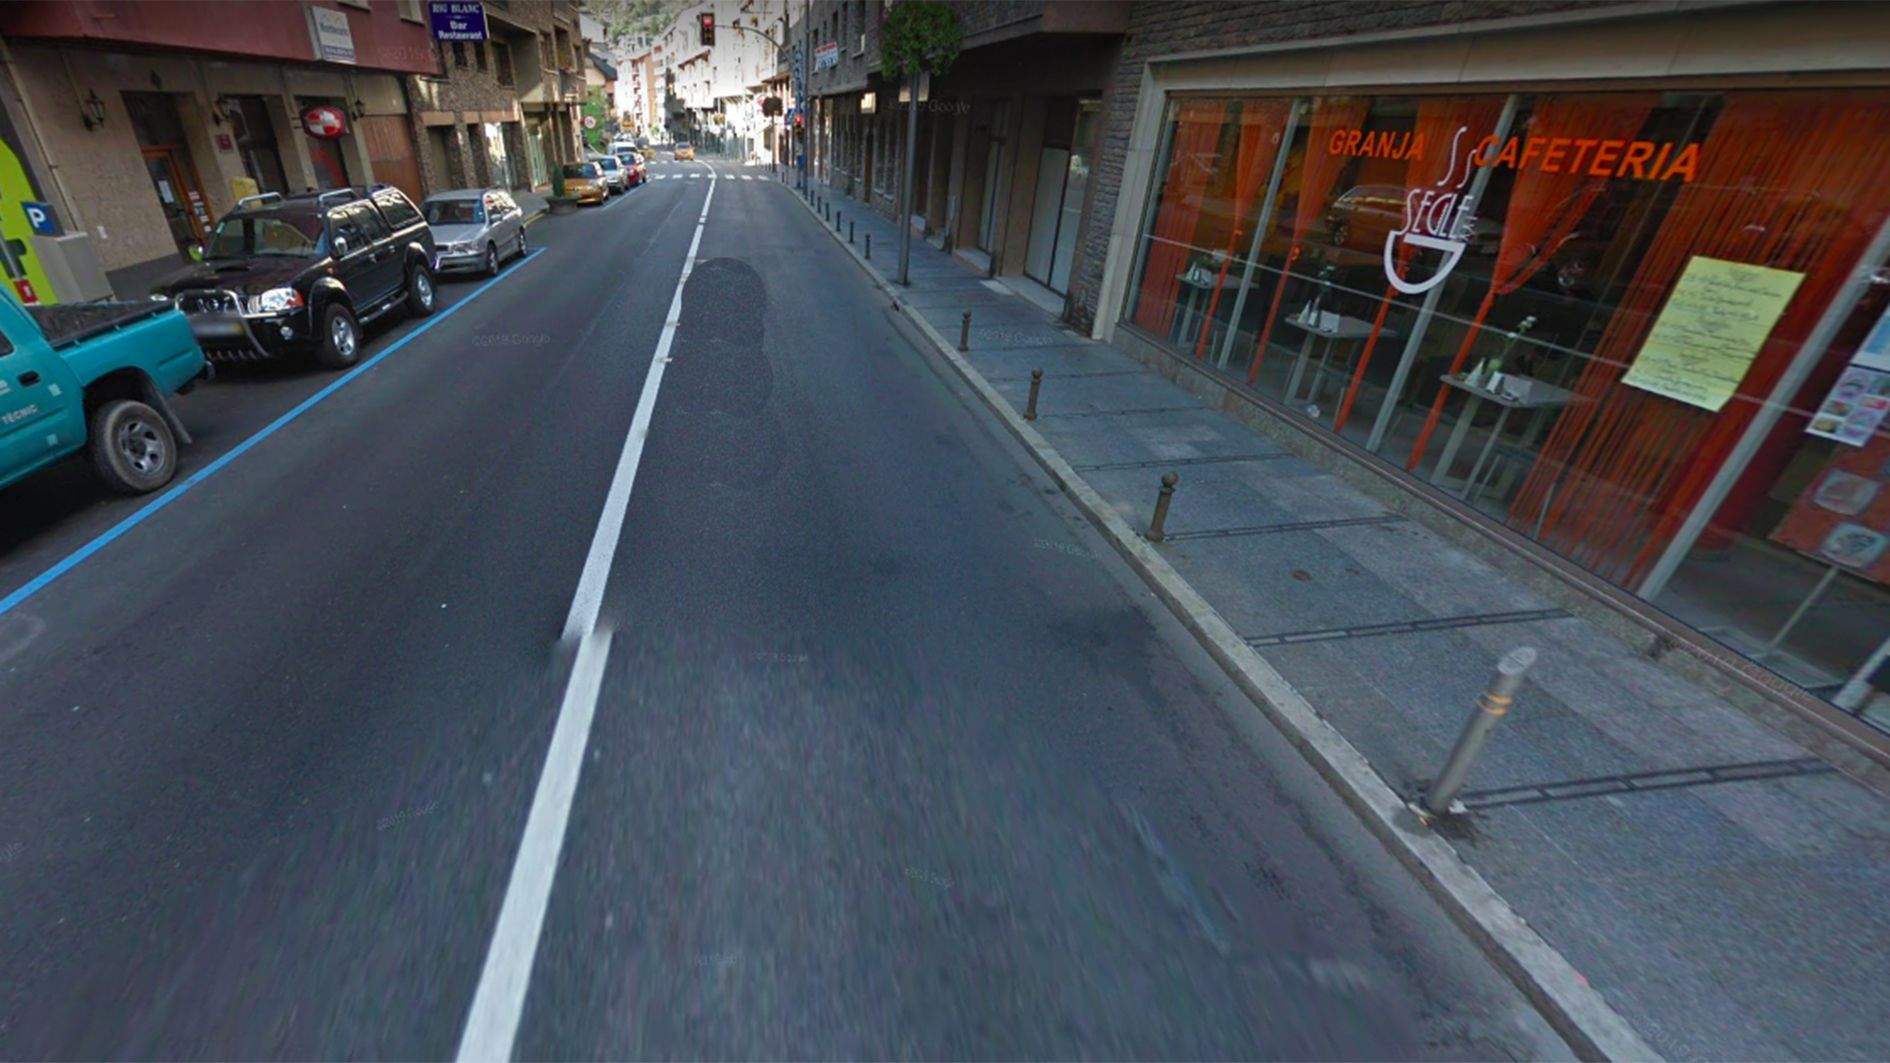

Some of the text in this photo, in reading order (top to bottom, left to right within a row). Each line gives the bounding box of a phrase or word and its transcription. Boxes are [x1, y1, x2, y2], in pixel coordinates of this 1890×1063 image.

[451, 4, 480, 14] BLANC
[450, 20, 467, 30] Bar
[438, 30, 483, 40] Restaurant
[1329, 129, 1700, 183] GRANJA CAFETERIA
[26, 207, 46, 229] P
